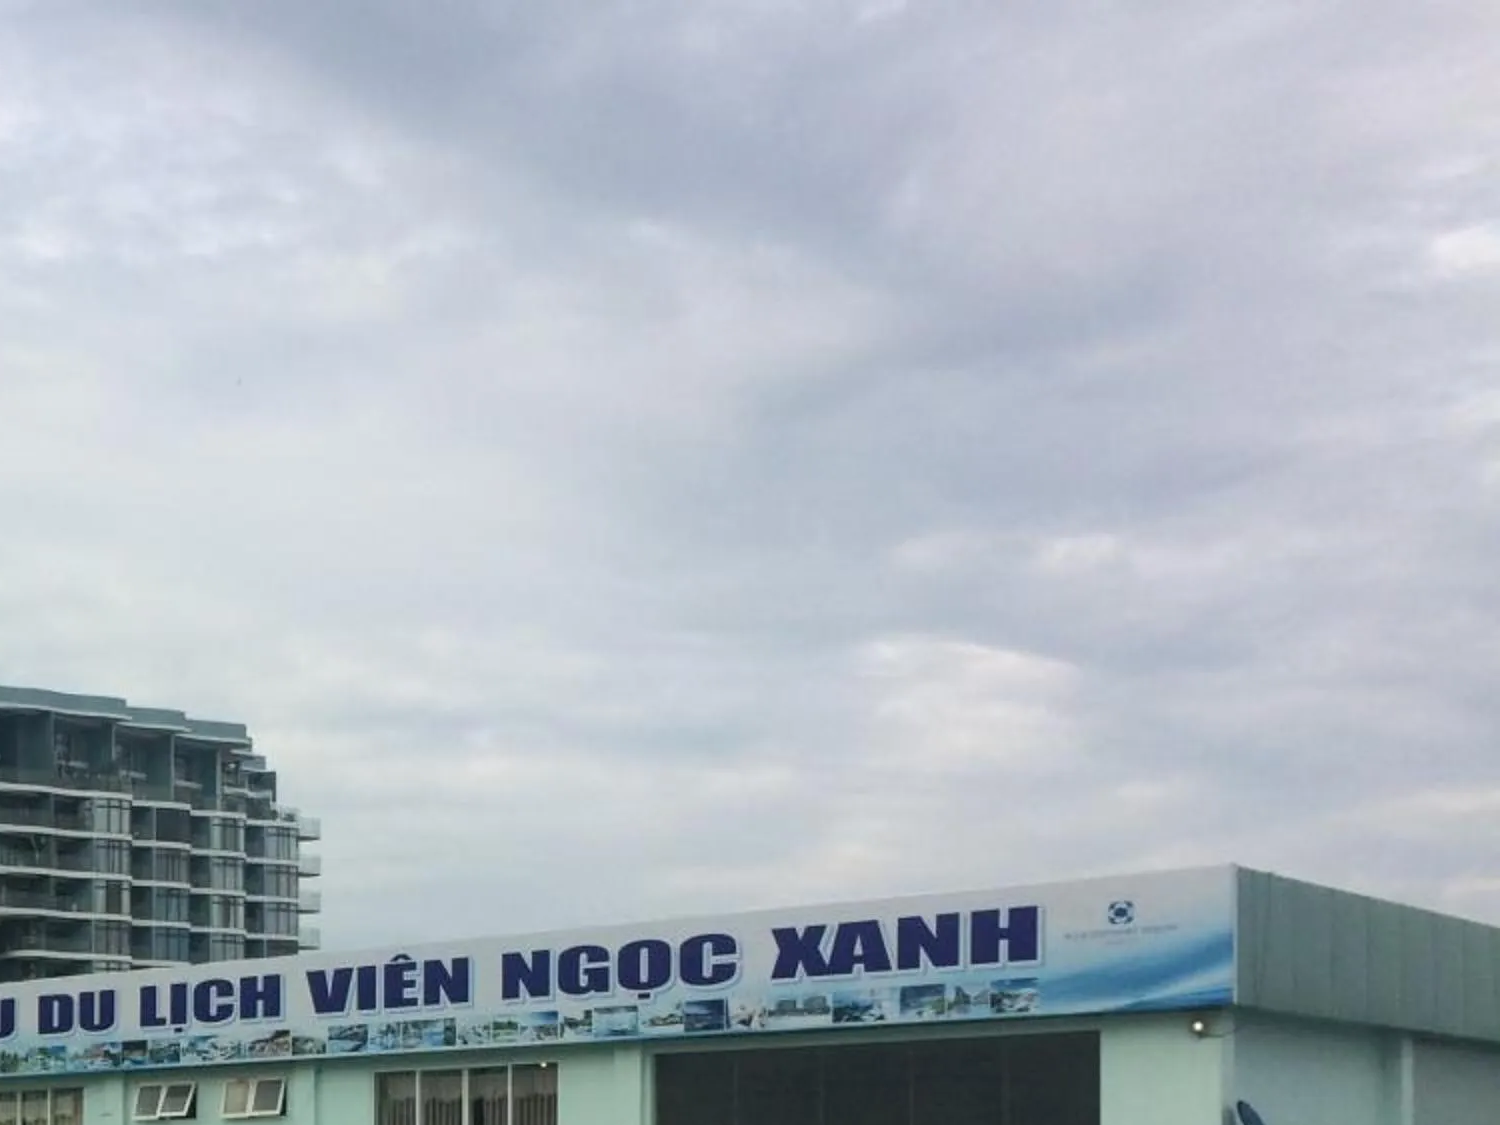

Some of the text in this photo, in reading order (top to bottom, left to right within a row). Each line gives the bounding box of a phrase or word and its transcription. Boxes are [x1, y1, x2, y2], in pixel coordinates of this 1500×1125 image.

[38, 990, 115, 1034] DU
[140, 974, 281, 1032] LỊCH
[306, 953, 469, 1014] VIÊN
[501, 934, 737, 999] NGỌC
[771, 906, 1038, 980] XANH
